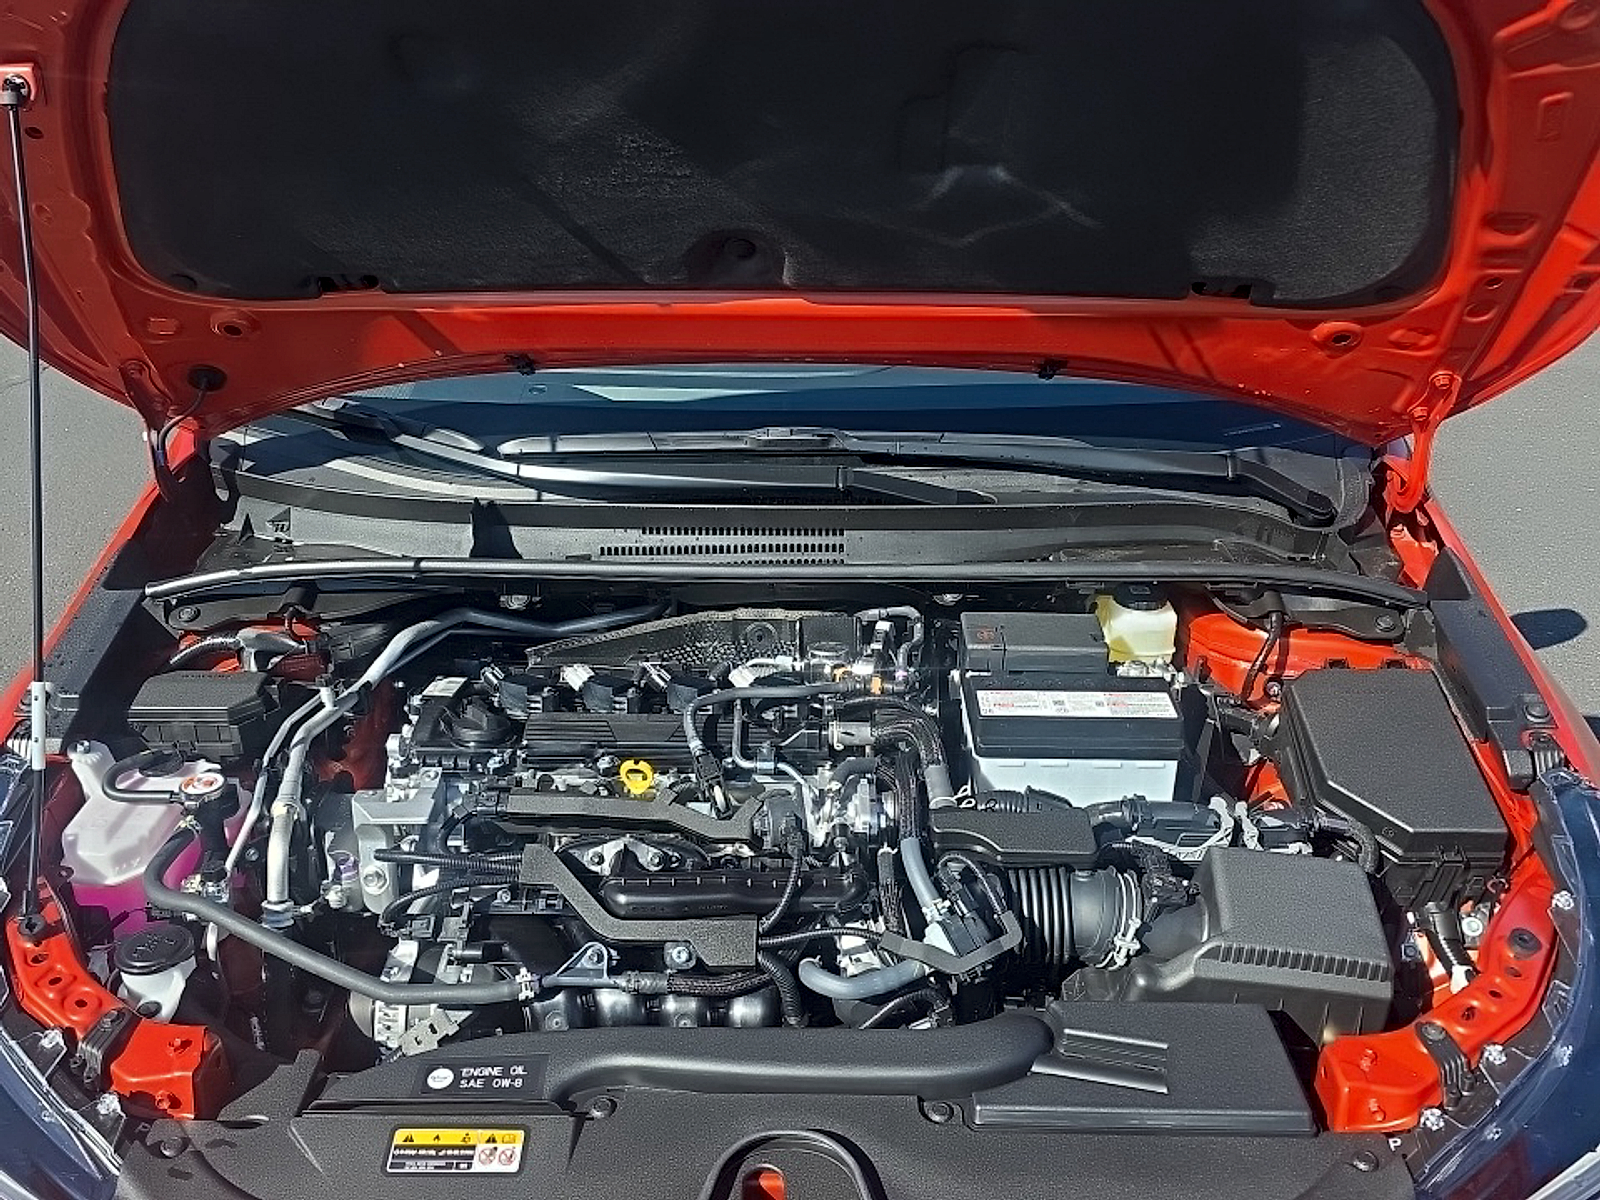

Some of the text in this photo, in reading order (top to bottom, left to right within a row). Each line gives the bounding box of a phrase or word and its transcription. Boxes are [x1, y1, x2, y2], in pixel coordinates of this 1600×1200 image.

[460, 1065, 528, 1077] ENGINE OIL
[459, 1078, 485, 1088] SAE
[1388, 1138, 1401, 1152] P
